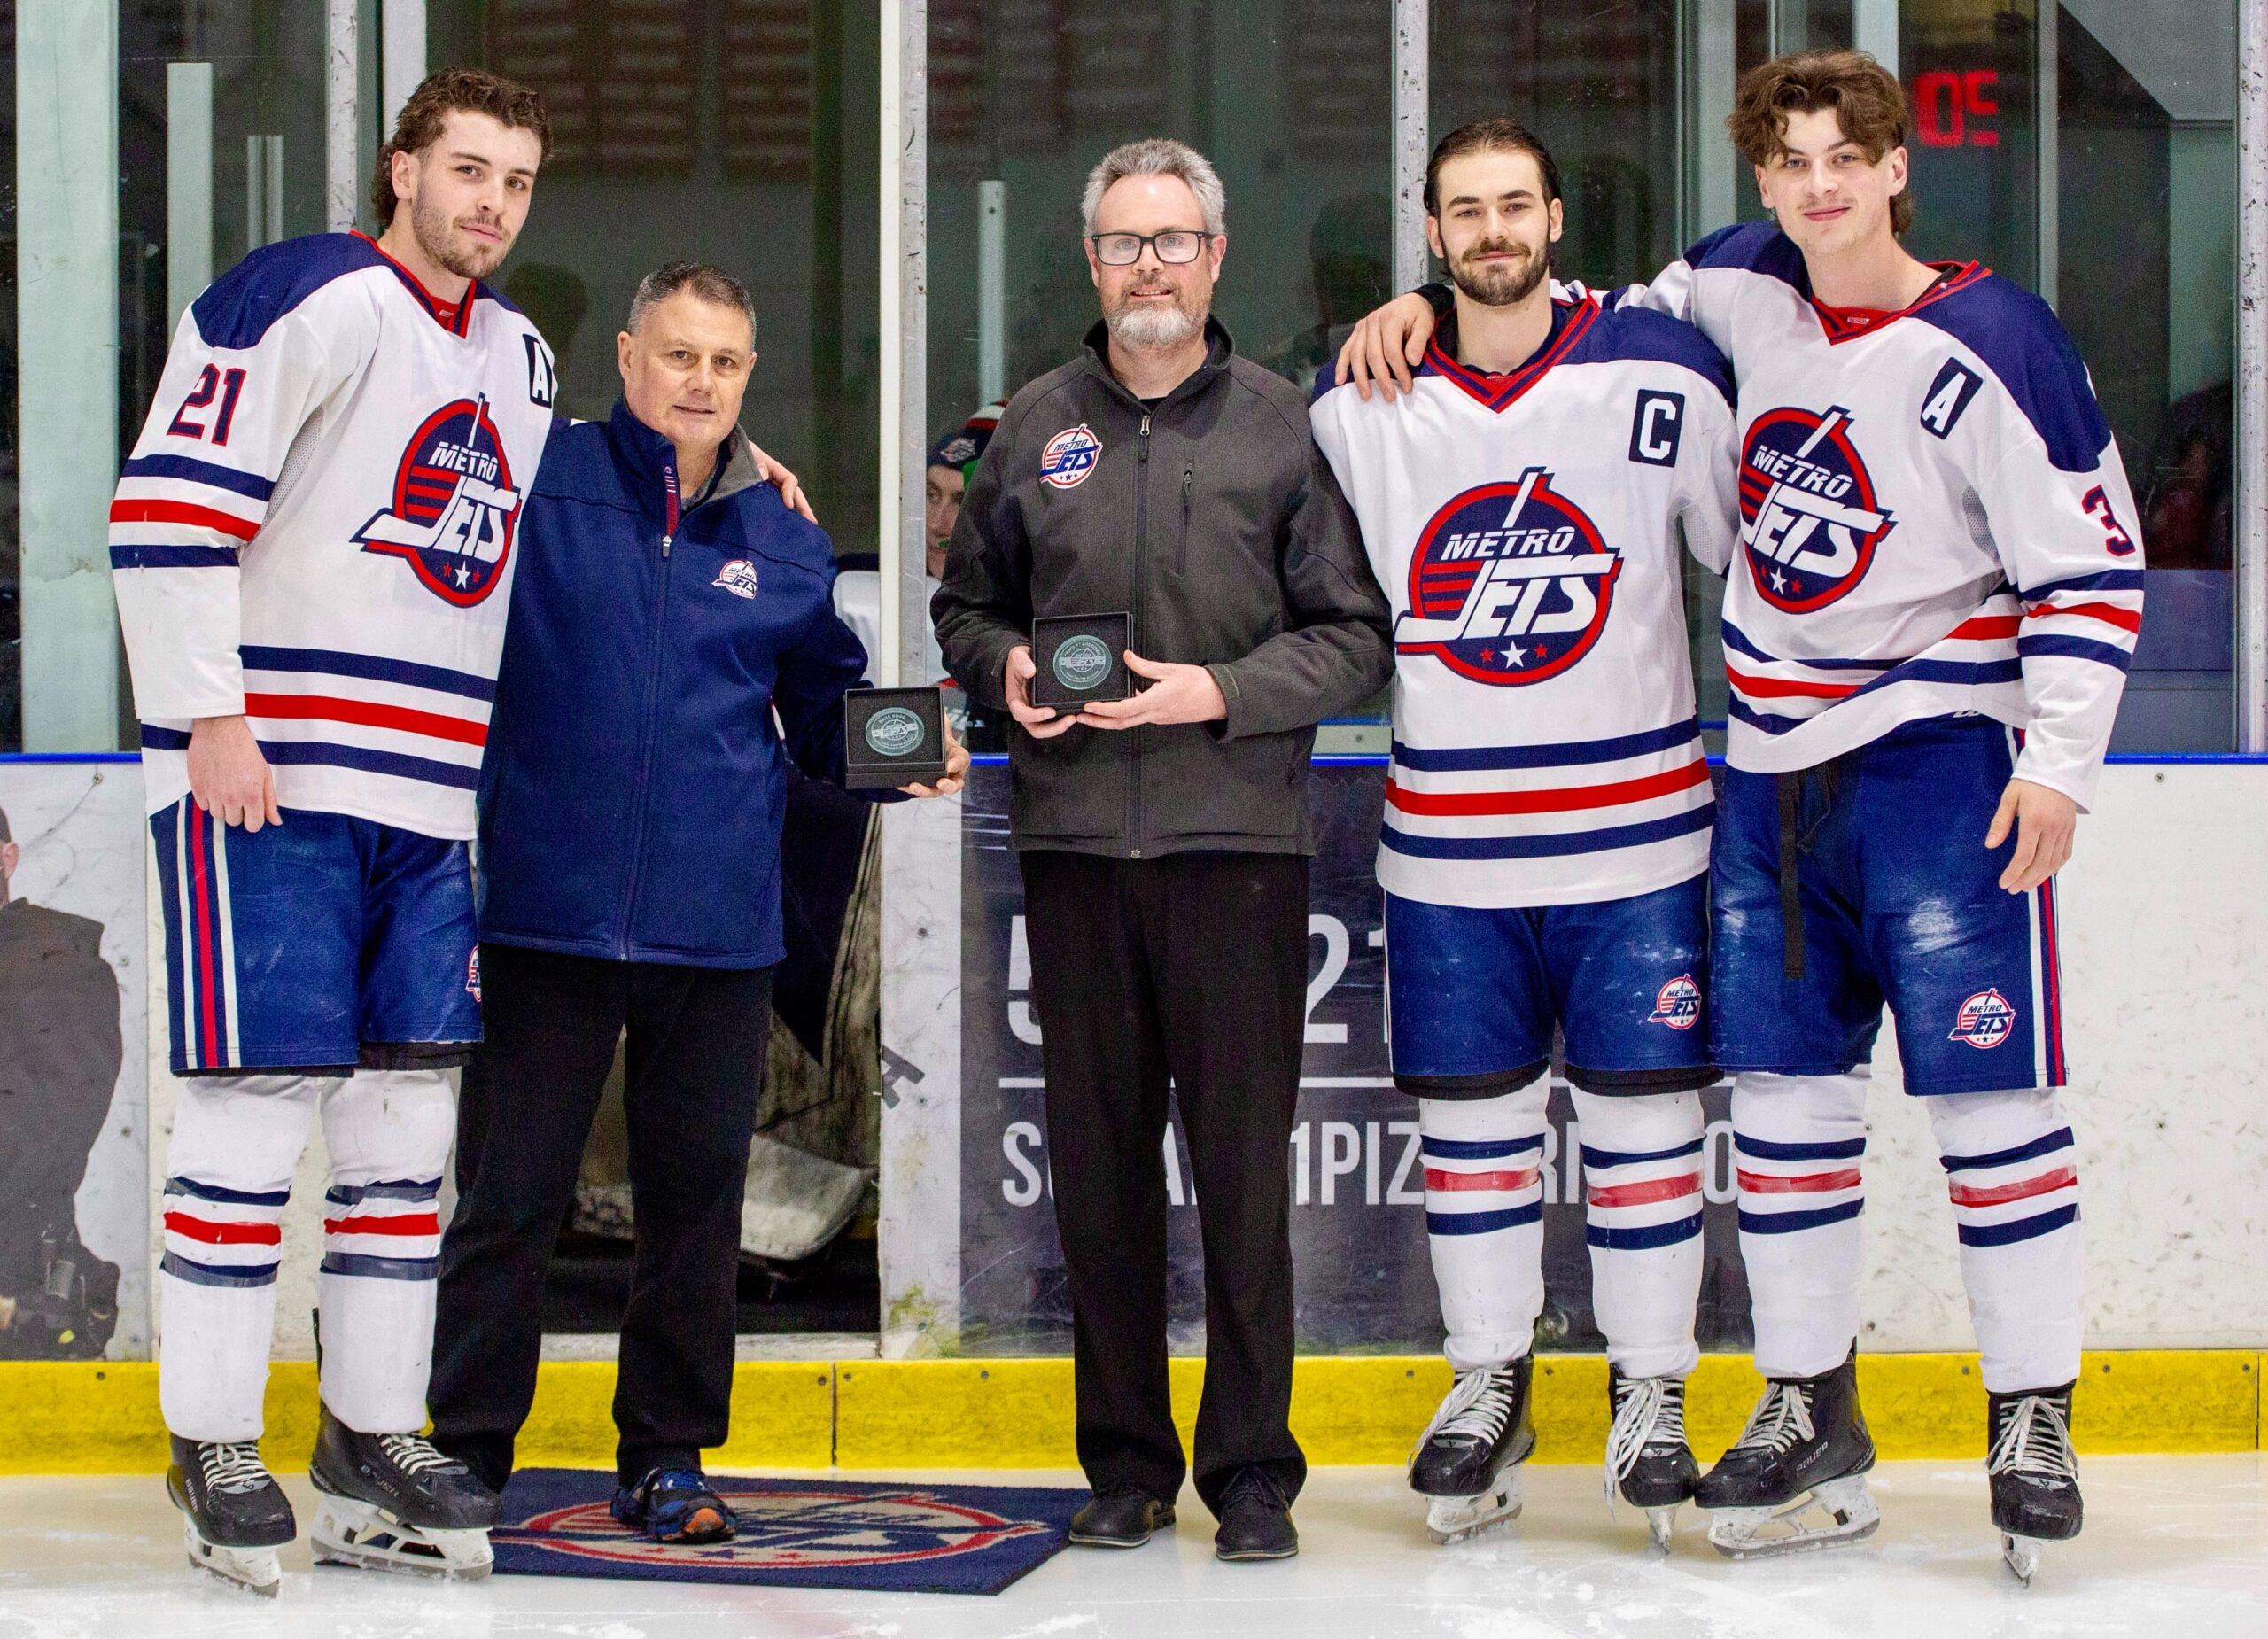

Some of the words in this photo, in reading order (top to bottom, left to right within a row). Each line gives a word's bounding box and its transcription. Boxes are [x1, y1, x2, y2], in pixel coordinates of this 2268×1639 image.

[532, 340, 550, 402] A
[166, 362, 246, 446] 21
[1638, 397, 1677, 460] C
[1922, 372, 1966, 431] A
[428, 440, 499, 482] METRO
[1040, 445, 1101, 479] JETS
[1054, 438, 1090, 455] METRO
[1751, 445, 1853, 499] METRO
[361, 475, 519, 563] JETS
[1441, 525, 1576, 562] METRO
[1742, 483, 1894, 578] JETS
[2081, 483, 2136, 557] 3
[1396, 553, 1620, 641] JETS
[1650, 995, 1700, 1020] JETS
[1666, 987, 1695, 998] METRO
[1968, 1004, 2003, 1014] METRO
[1951, 1011, 2014, 1037] JETS
